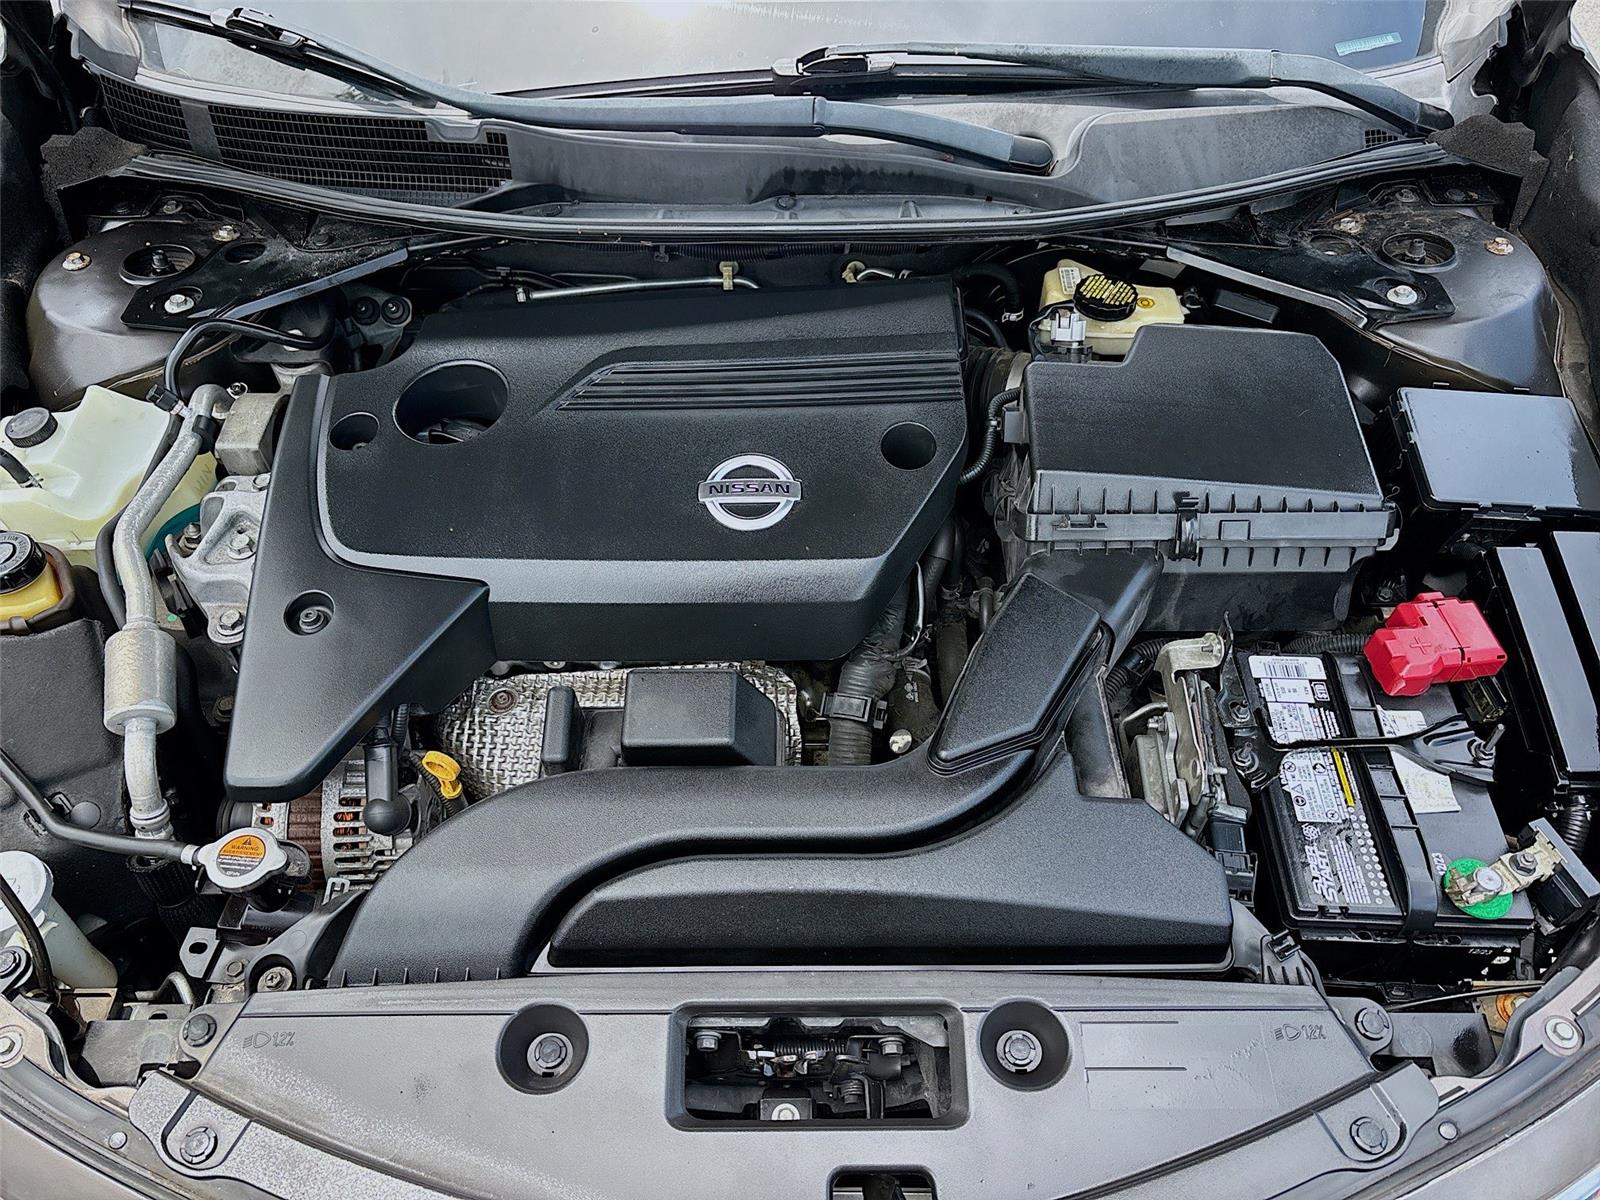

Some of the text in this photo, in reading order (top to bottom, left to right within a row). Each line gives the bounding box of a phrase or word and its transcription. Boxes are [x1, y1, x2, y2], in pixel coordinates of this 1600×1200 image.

[709, 483, 790, 495] NISSAN
[1305, 845, 1323, 895] SUPER
[1316, 848, 1339, 903] START
